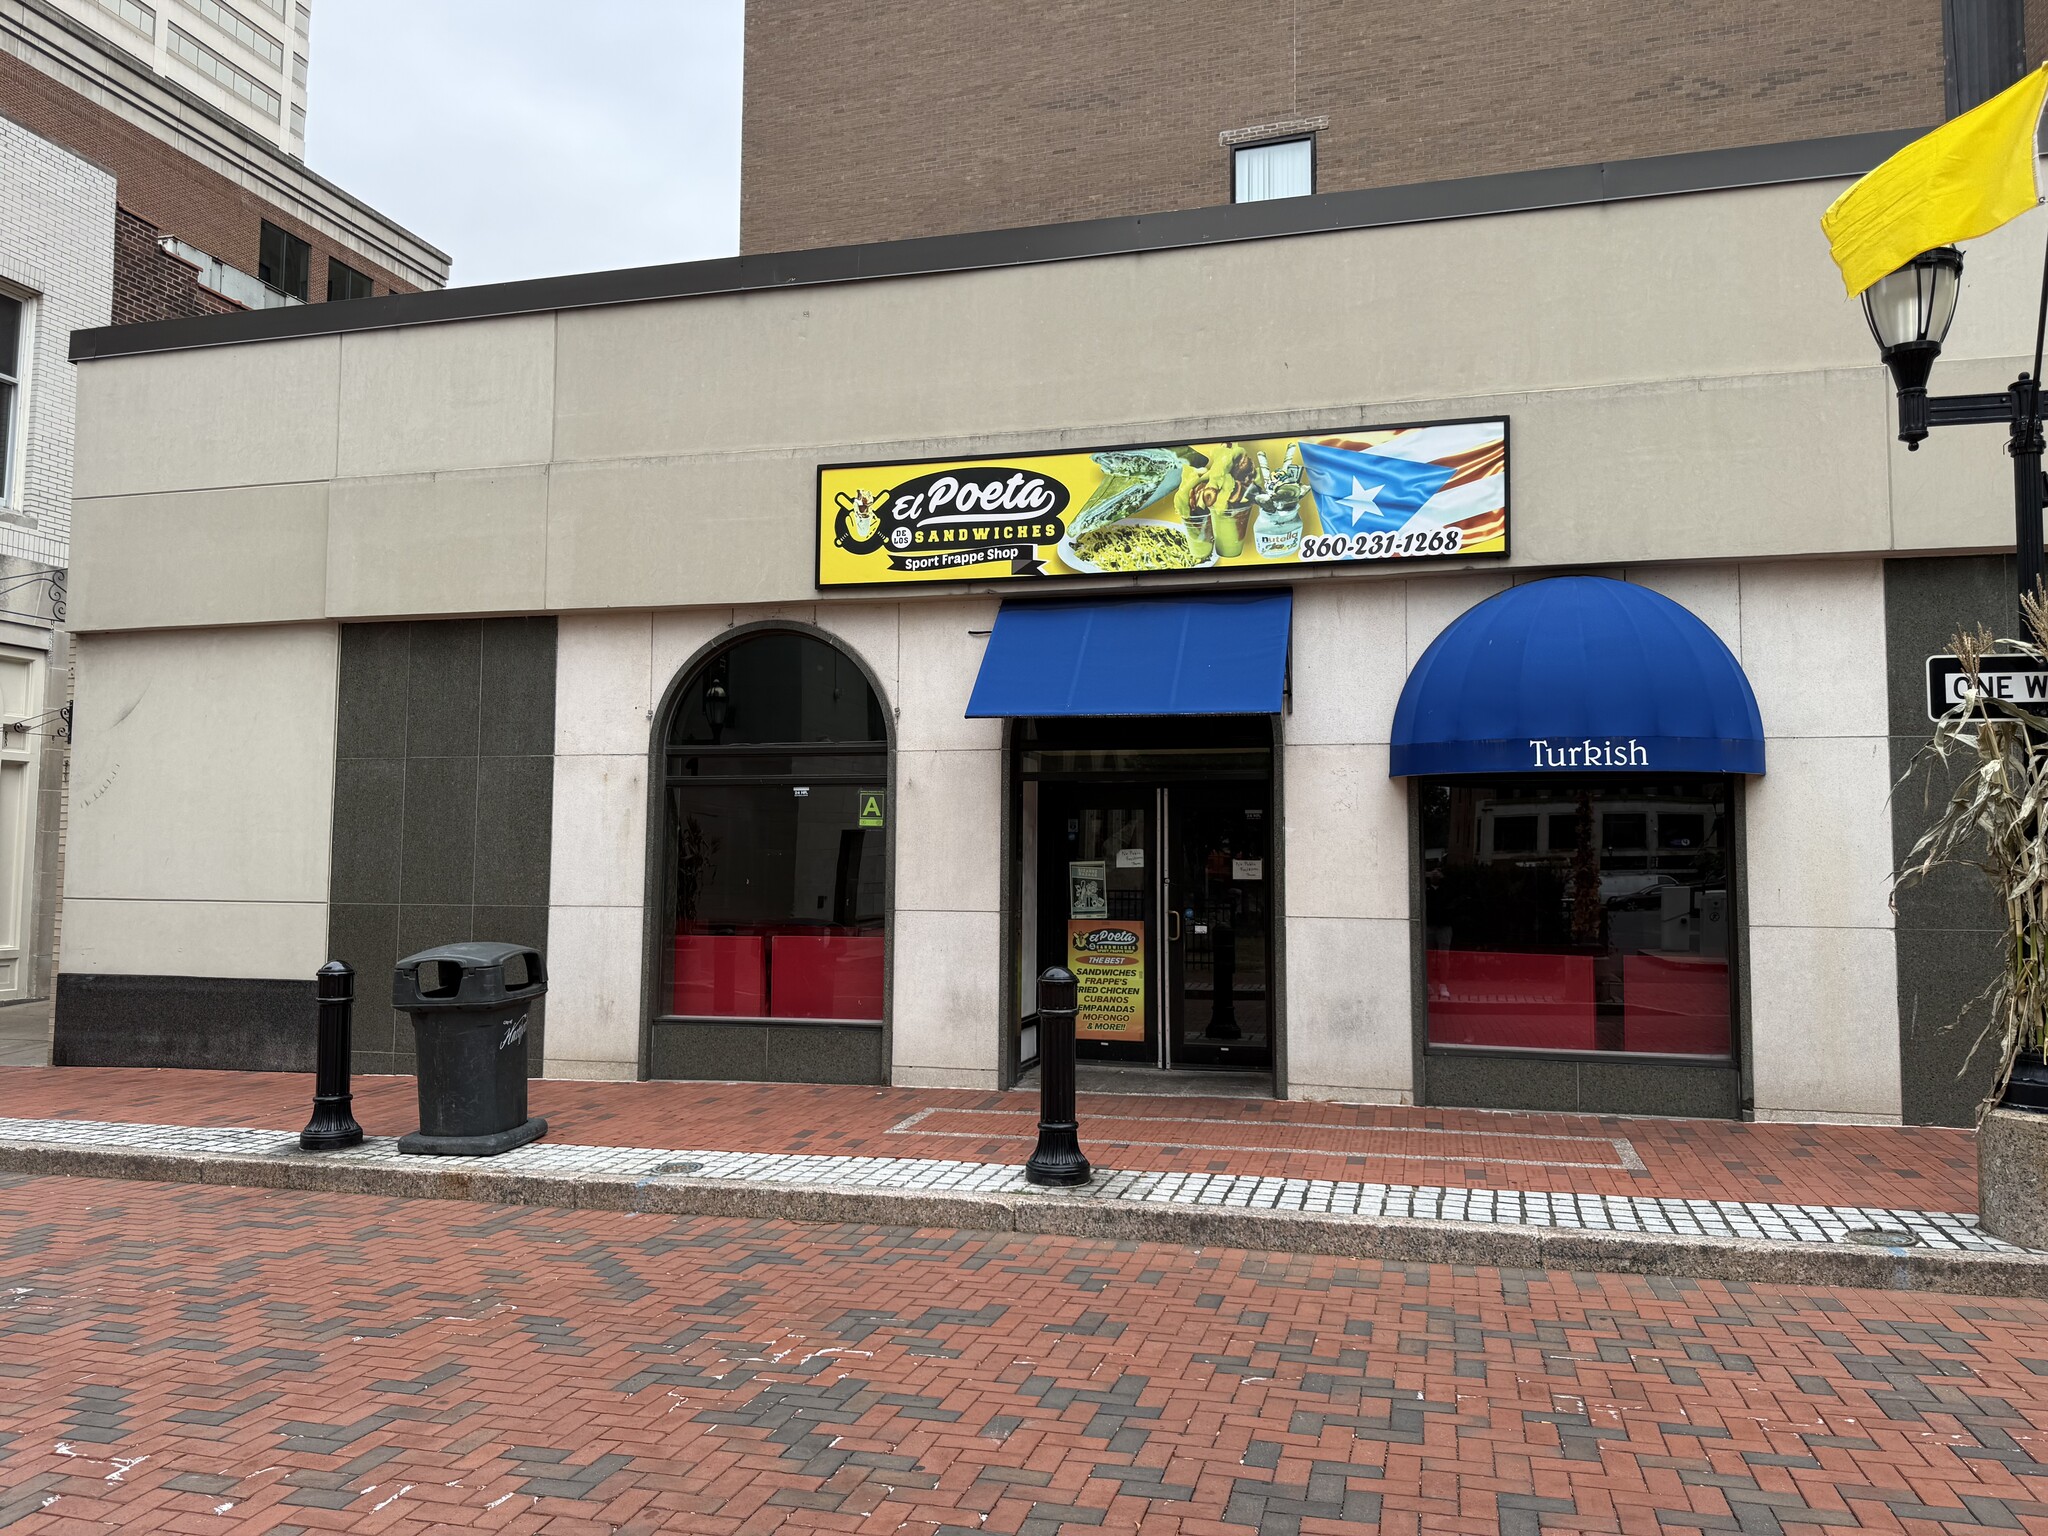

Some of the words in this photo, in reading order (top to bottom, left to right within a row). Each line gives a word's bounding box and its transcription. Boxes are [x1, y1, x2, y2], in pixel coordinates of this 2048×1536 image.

[892, 493, 925, 520] El
[918, 472, 1055, 526] Poeta
[893, 537, 909, 545] LOS
[914, 524, 1056, 543] SANDWICHES
[1302, 530, 1459, 559] 860-231-1268
[905, 556, 939, 572] Sport
[942, 552, 984, 568] Frappe
[987, 547, 1019, 562] Shop
[1953, 676, 2014, 699] ONE
[1529, 739, 1649, 767] Turkish
[862, 796, 881, 816] A
[1097, 930, 1136, 944] Poeta
[1076, 968, 1137, 976] SANDWICHES
[1078, 1004, 1135, 1013] EMPANADAS
[1083, 1013, 1130, 1021] MOFONGO
